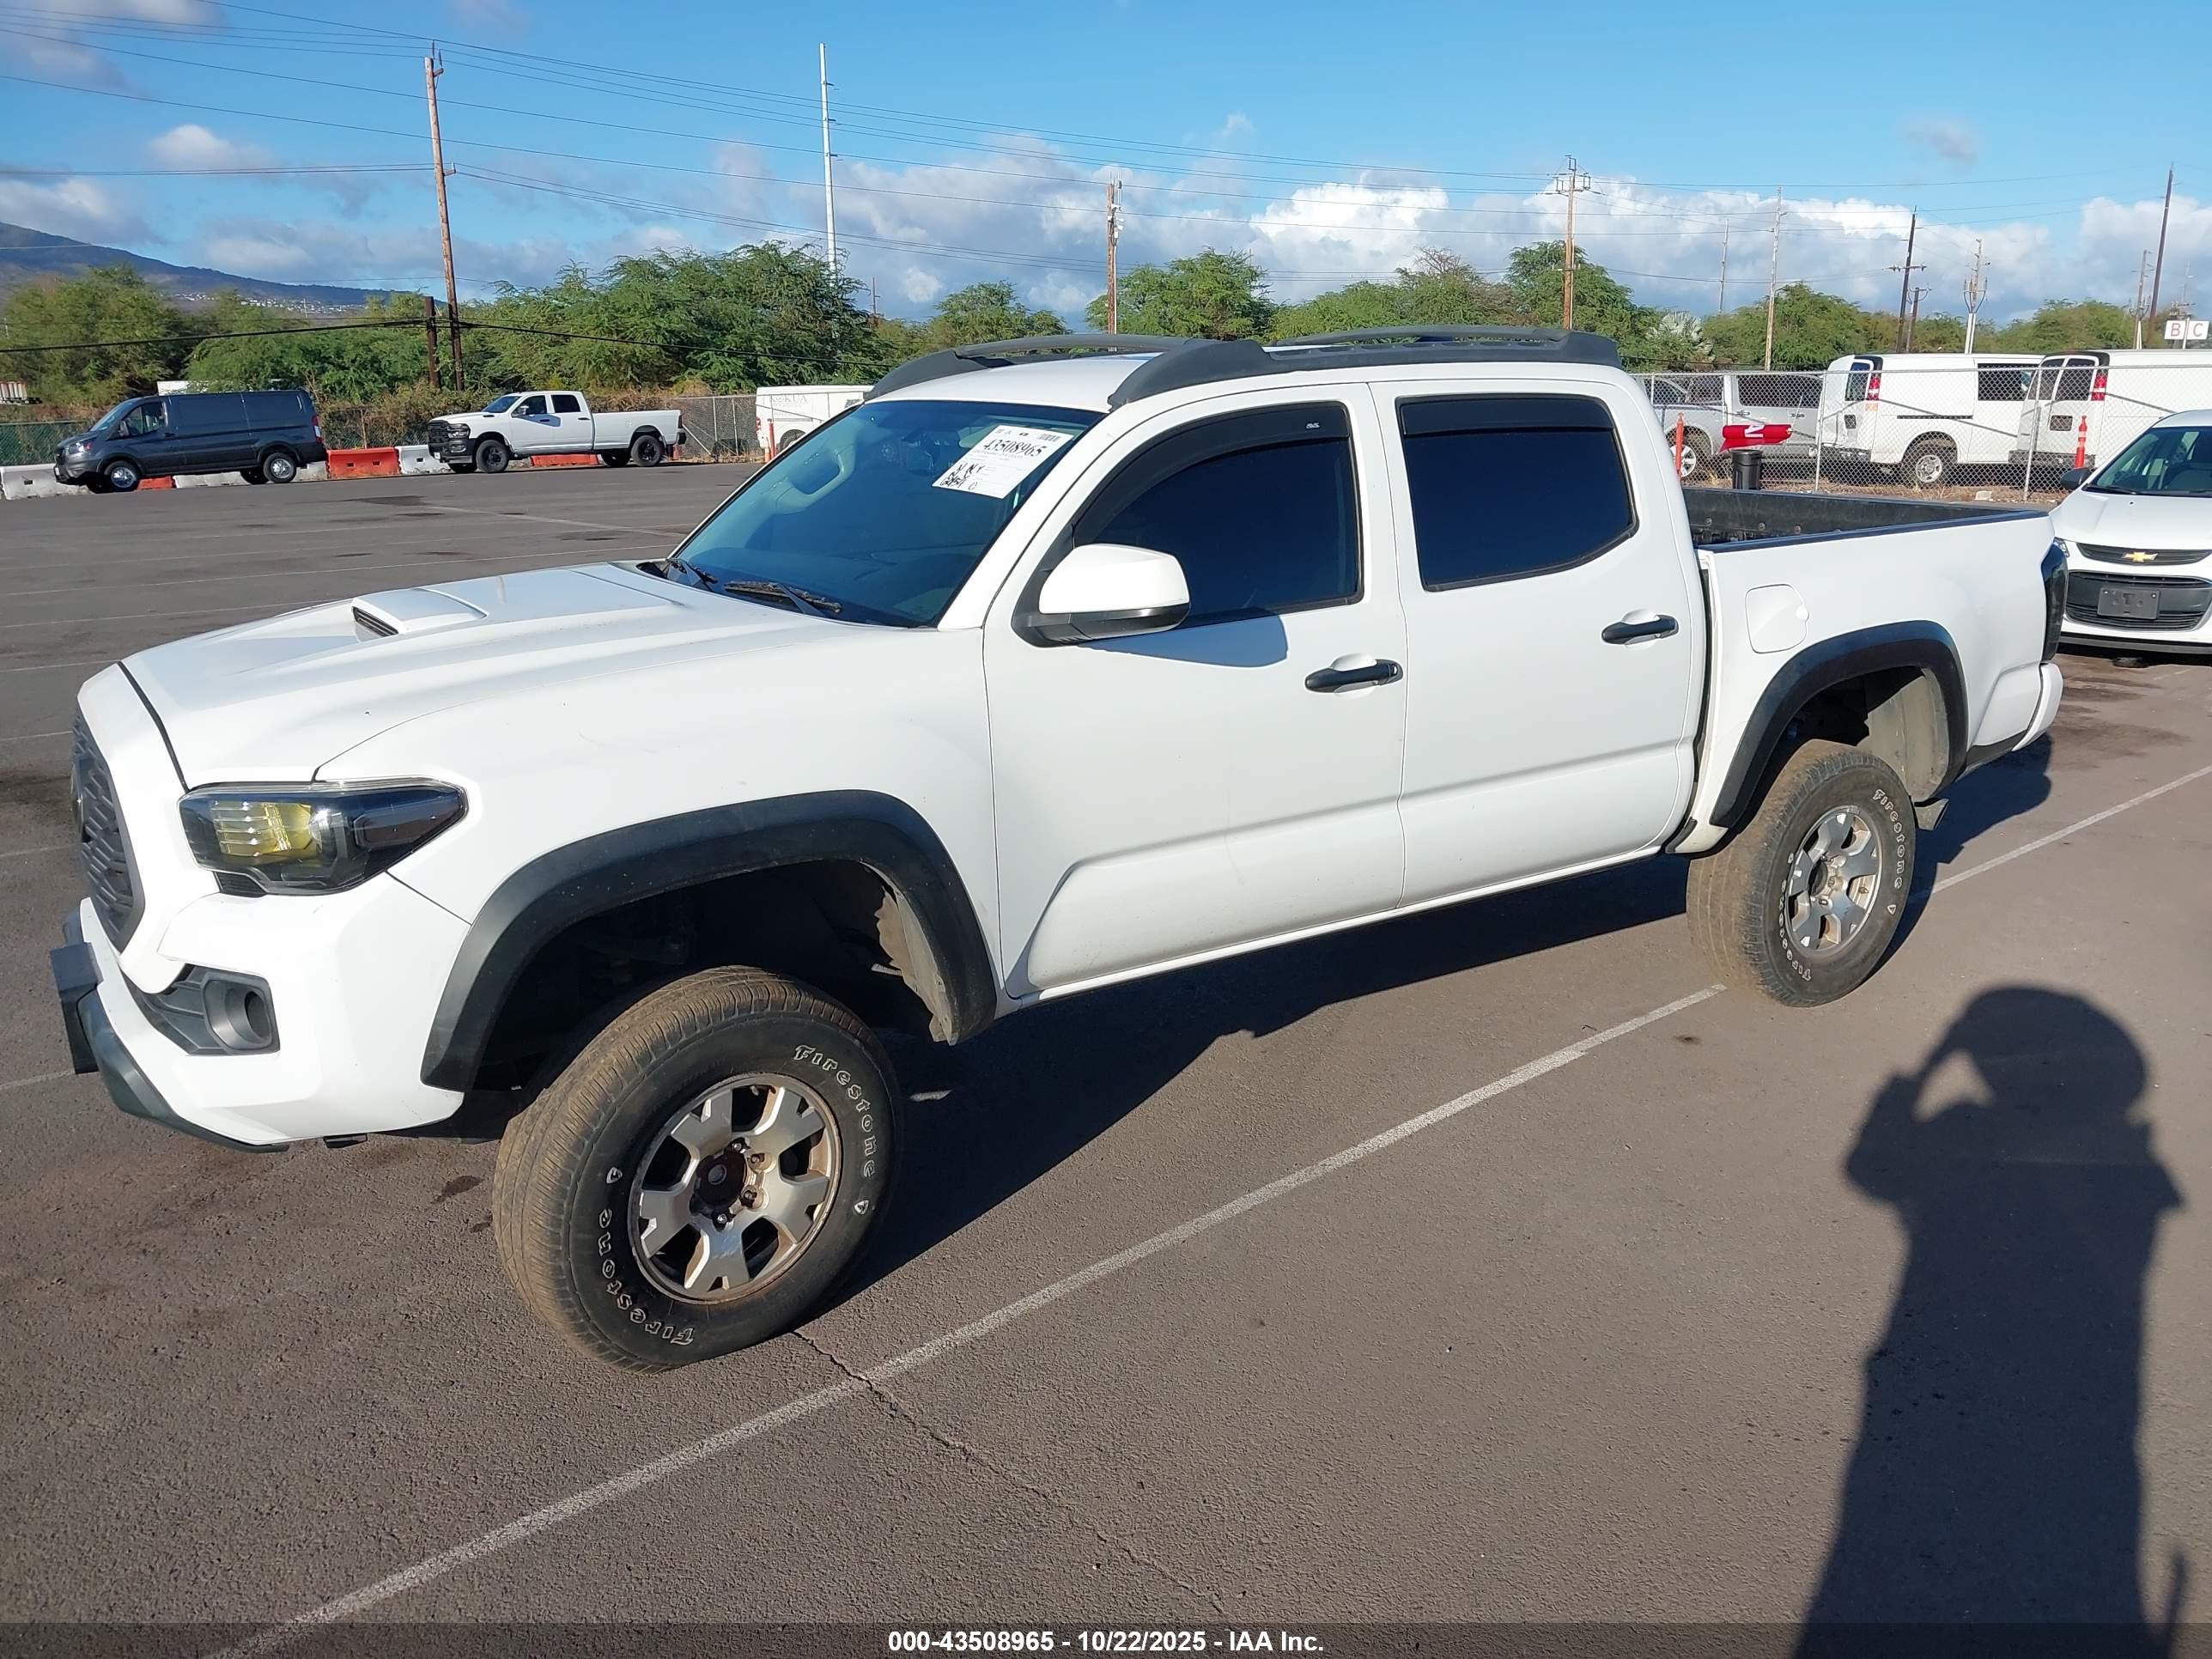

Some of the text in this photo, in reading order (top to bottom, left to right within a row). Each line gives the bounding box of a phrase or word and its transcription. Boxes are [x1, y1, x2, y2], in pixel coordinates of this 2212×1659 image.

[2171, 322, 2204, 337] B C
[984, 439, 1048, 457] 43508965
[1872, 788, 1905, 890] Firestone
[793, 1044, 877, 1178] Firestone
[598, 1208, 694, 1346] Firestone
